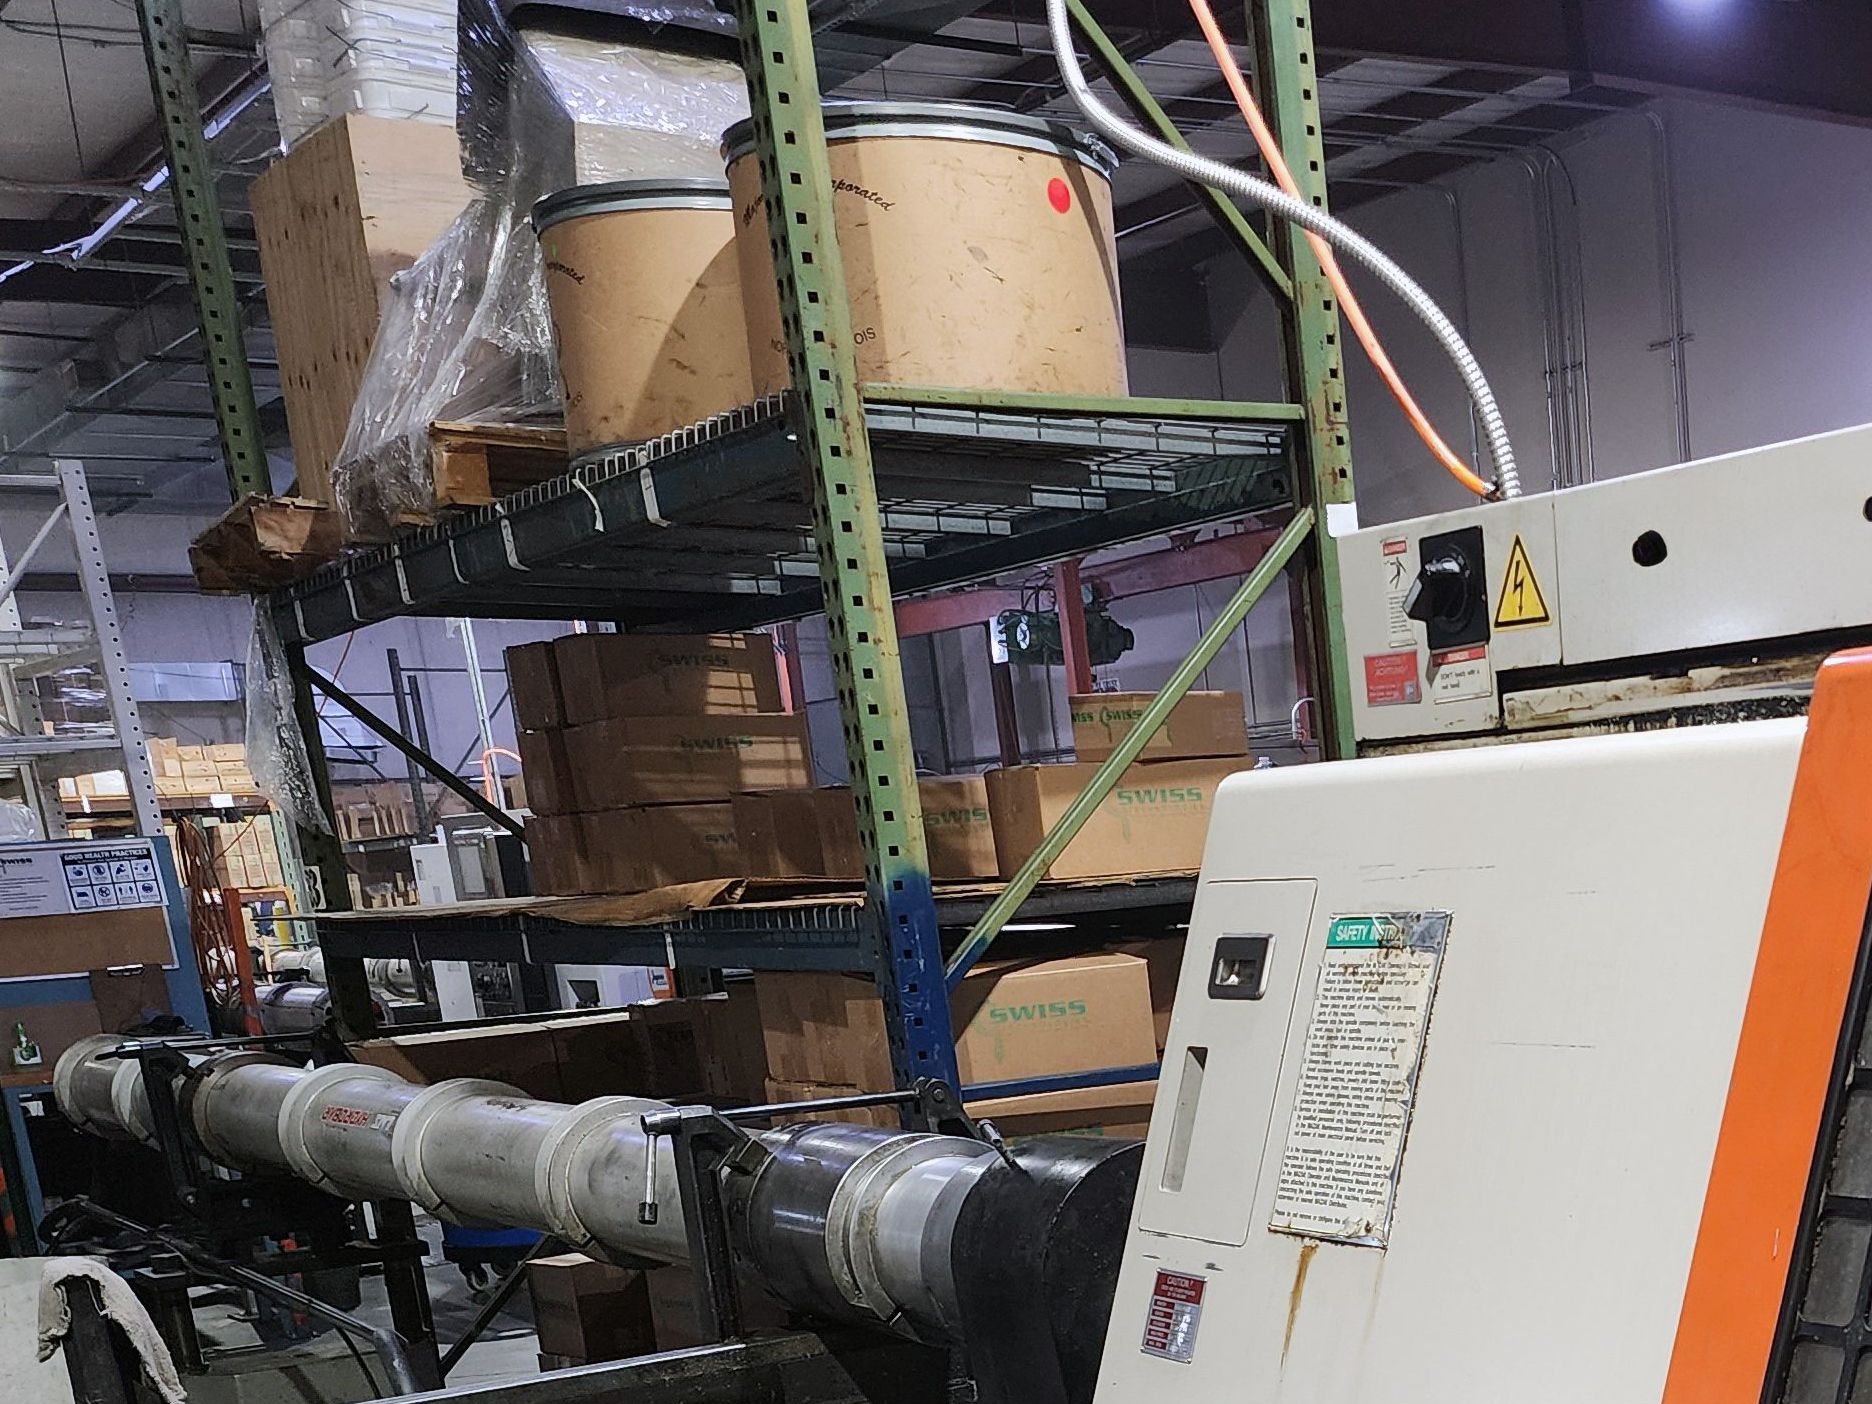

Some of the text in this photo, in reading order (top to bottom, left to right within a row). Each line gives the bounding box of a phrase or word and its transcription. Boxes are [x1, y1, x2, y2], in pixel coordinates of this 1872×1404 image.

[1116, 787, 1203, 807] SWISS
[84, 850, 110, 860] HEALTH
[111, 848, 148, 858] PRACTICES
[1335, 924, 1369, 942] SAFETY
[989, 1000, 1087, 1024] SWISS
